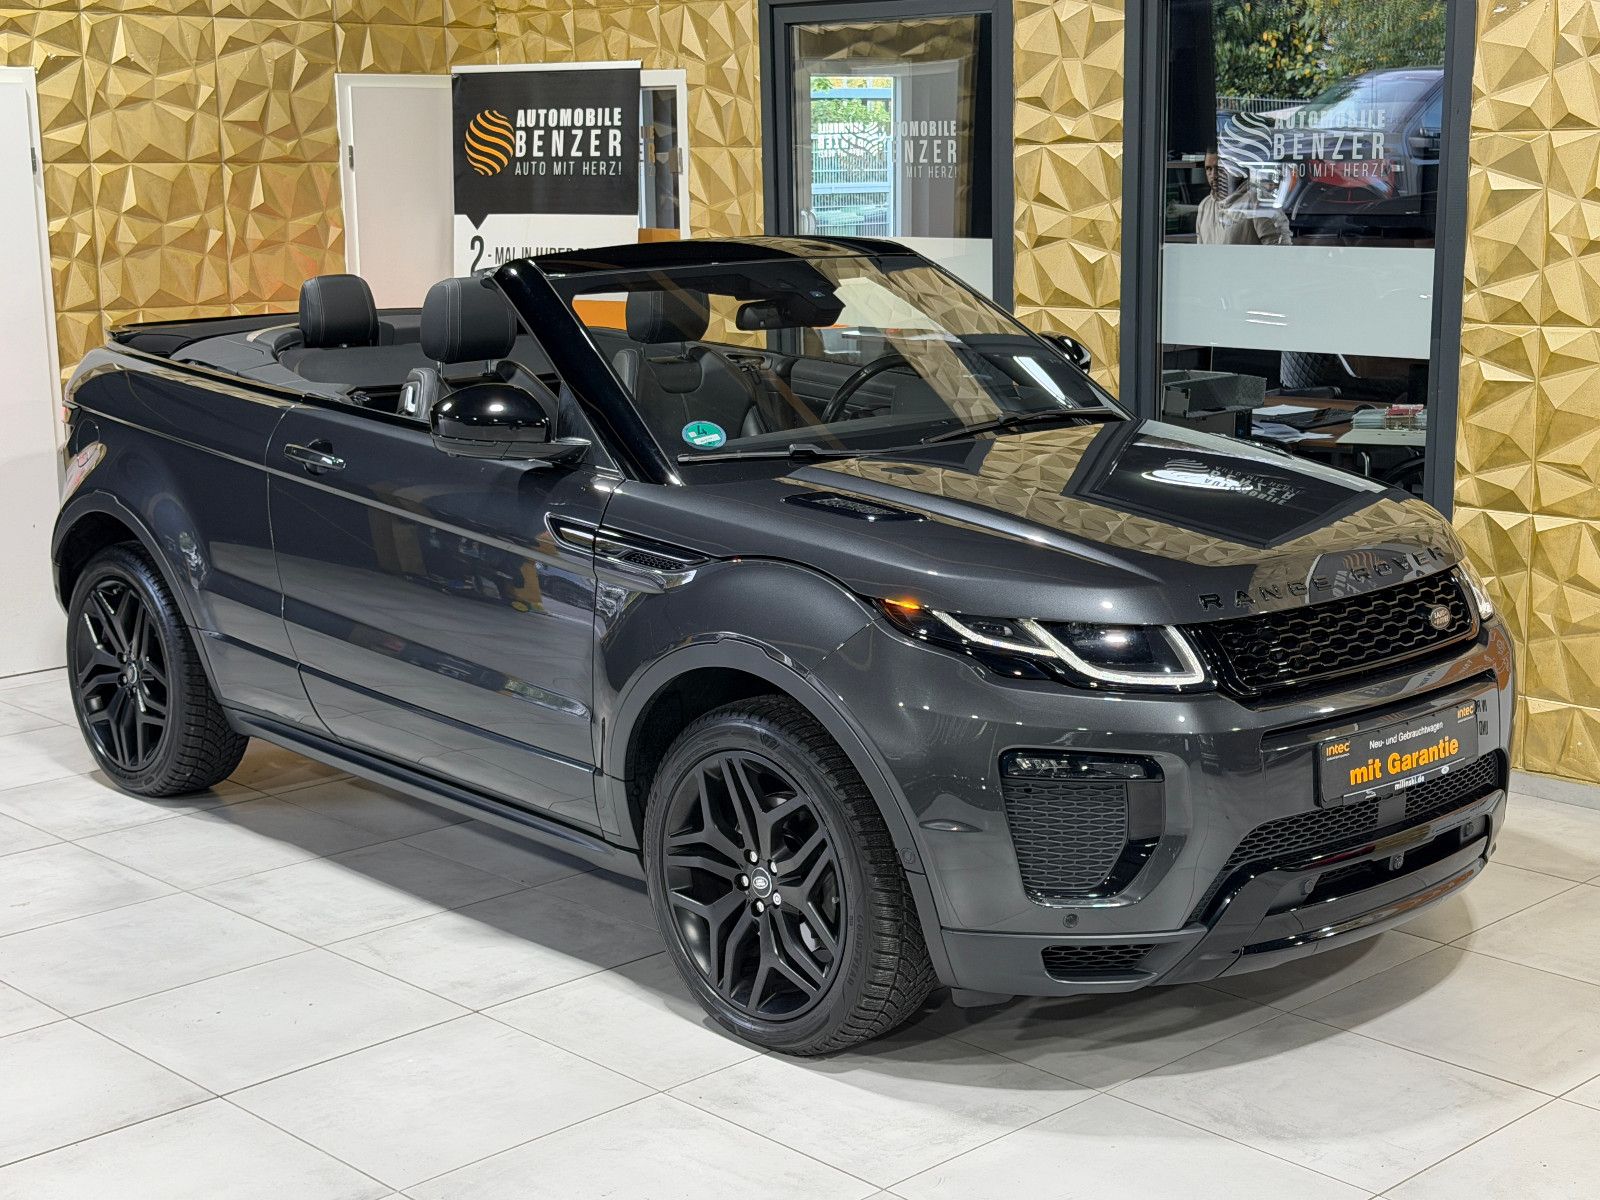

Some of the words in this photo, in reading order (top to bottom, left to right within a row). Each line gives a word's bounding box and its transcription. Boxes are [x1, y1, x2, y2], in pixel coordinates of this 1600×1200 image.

[516, 107, 622, 128] AUTOMOBILE
[1274, 109, 1386, 130] AUTOMOBILE
[515, 129, 622, 158] BENZER
[1273, 132, 1386, 161] BENZER
[515, 161, 546, 176] AUTO
[553, 161, 574, 176] MIT
[582, 161, 622, 176] HERZ!
[905, 165, 923, 179] MIT
[928, 165, 957, 179] HERZ!
[1273, 162, 1306, 178] UTO
[1313, 162, 1336, 178] MIT
[470, 235, 484, 277] 2
[1198, 574, 1334, 611] RANGE
[1349, 545, 1447, 582] ROVER
[1369, 739, 1385, 750] Neu-
[1385, 734, 1398, 746] und
[1398, 721, 1444, 742] Gebrauchtwagen
[1350, 758, 1382, 786] mit
[1387, 735, 1459, 775] Garantie
